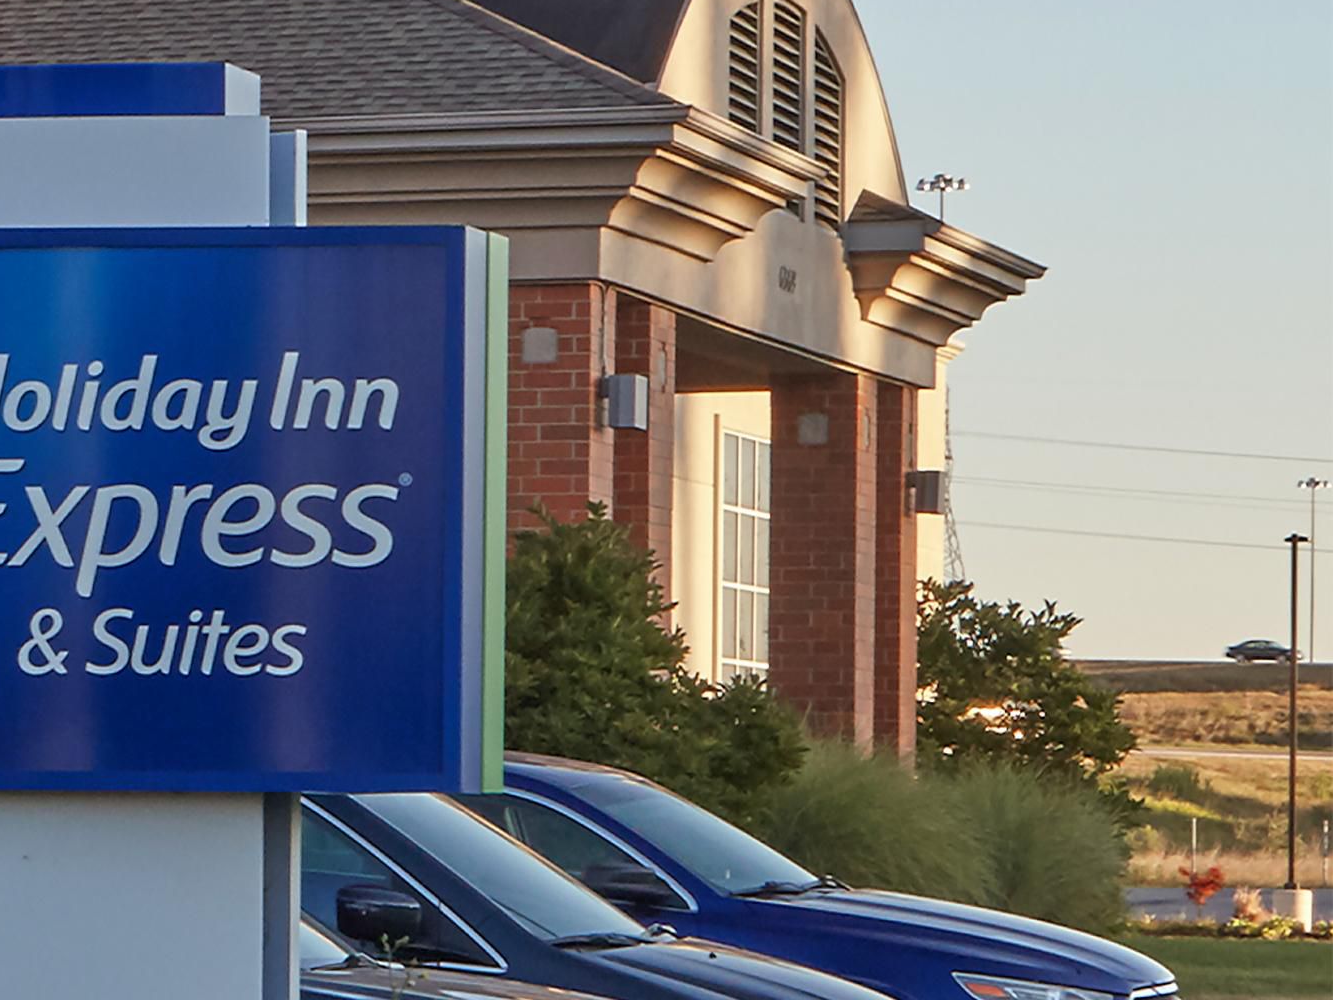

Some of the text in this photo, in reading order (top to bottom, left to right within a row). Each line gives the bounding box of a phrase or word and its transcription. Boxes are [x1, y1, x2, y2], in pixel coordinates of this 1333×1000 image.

[270, 351, 399, 431] Inn
[17, 608, 307, 676] & Suites
